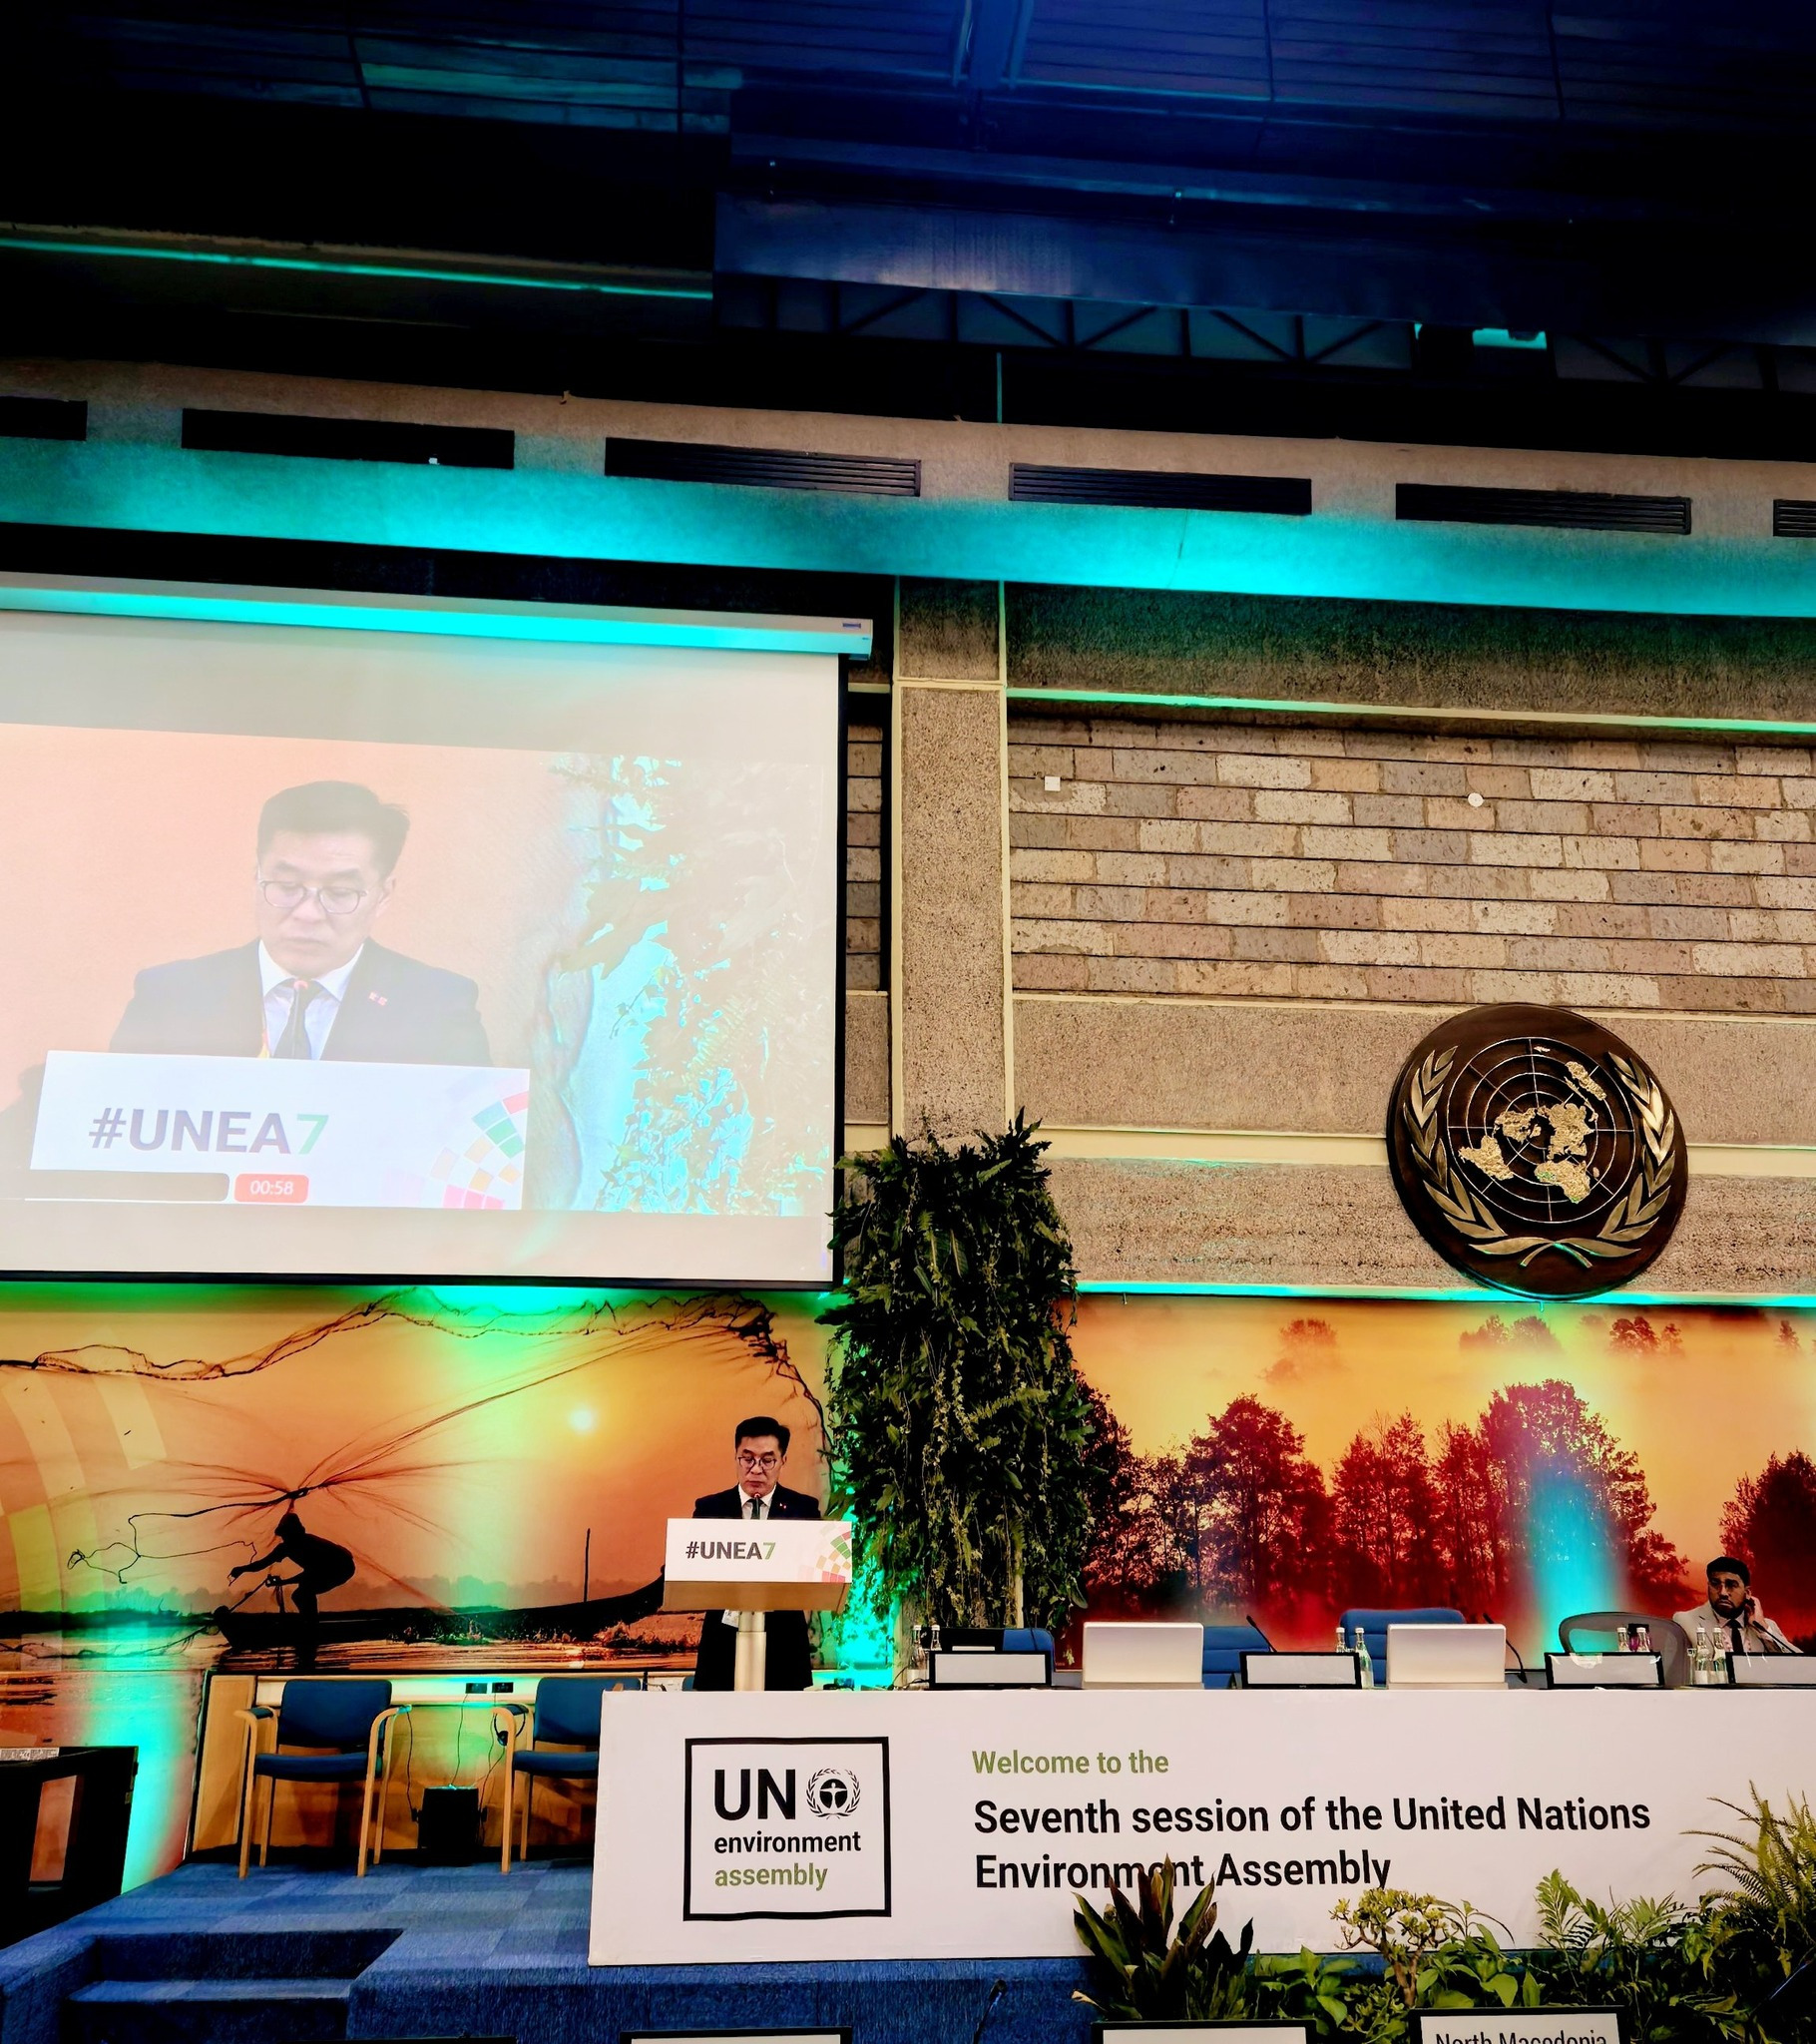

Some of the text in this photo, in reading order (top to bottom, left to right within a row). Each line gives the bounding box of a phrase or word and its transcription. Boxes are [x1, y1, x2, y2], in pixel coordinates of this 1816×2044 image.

[89, 1107, 329, 1155] #UNEA7
[248, 1180, 295, 1197] 00:58
[685, 1541, 776, 1560] #UNEA7
[972, 1750, 1169, 1775] Welcome to the
[714, 1769, 795, 1820] UN
[975, 1796, 1650, 1833] Seventh session of the United Nations
[714, 1830, 861, 1853] environment
[715, 1862, 828, 1891] assembly
[1216, 1849, 1391, 1889] Assembly
